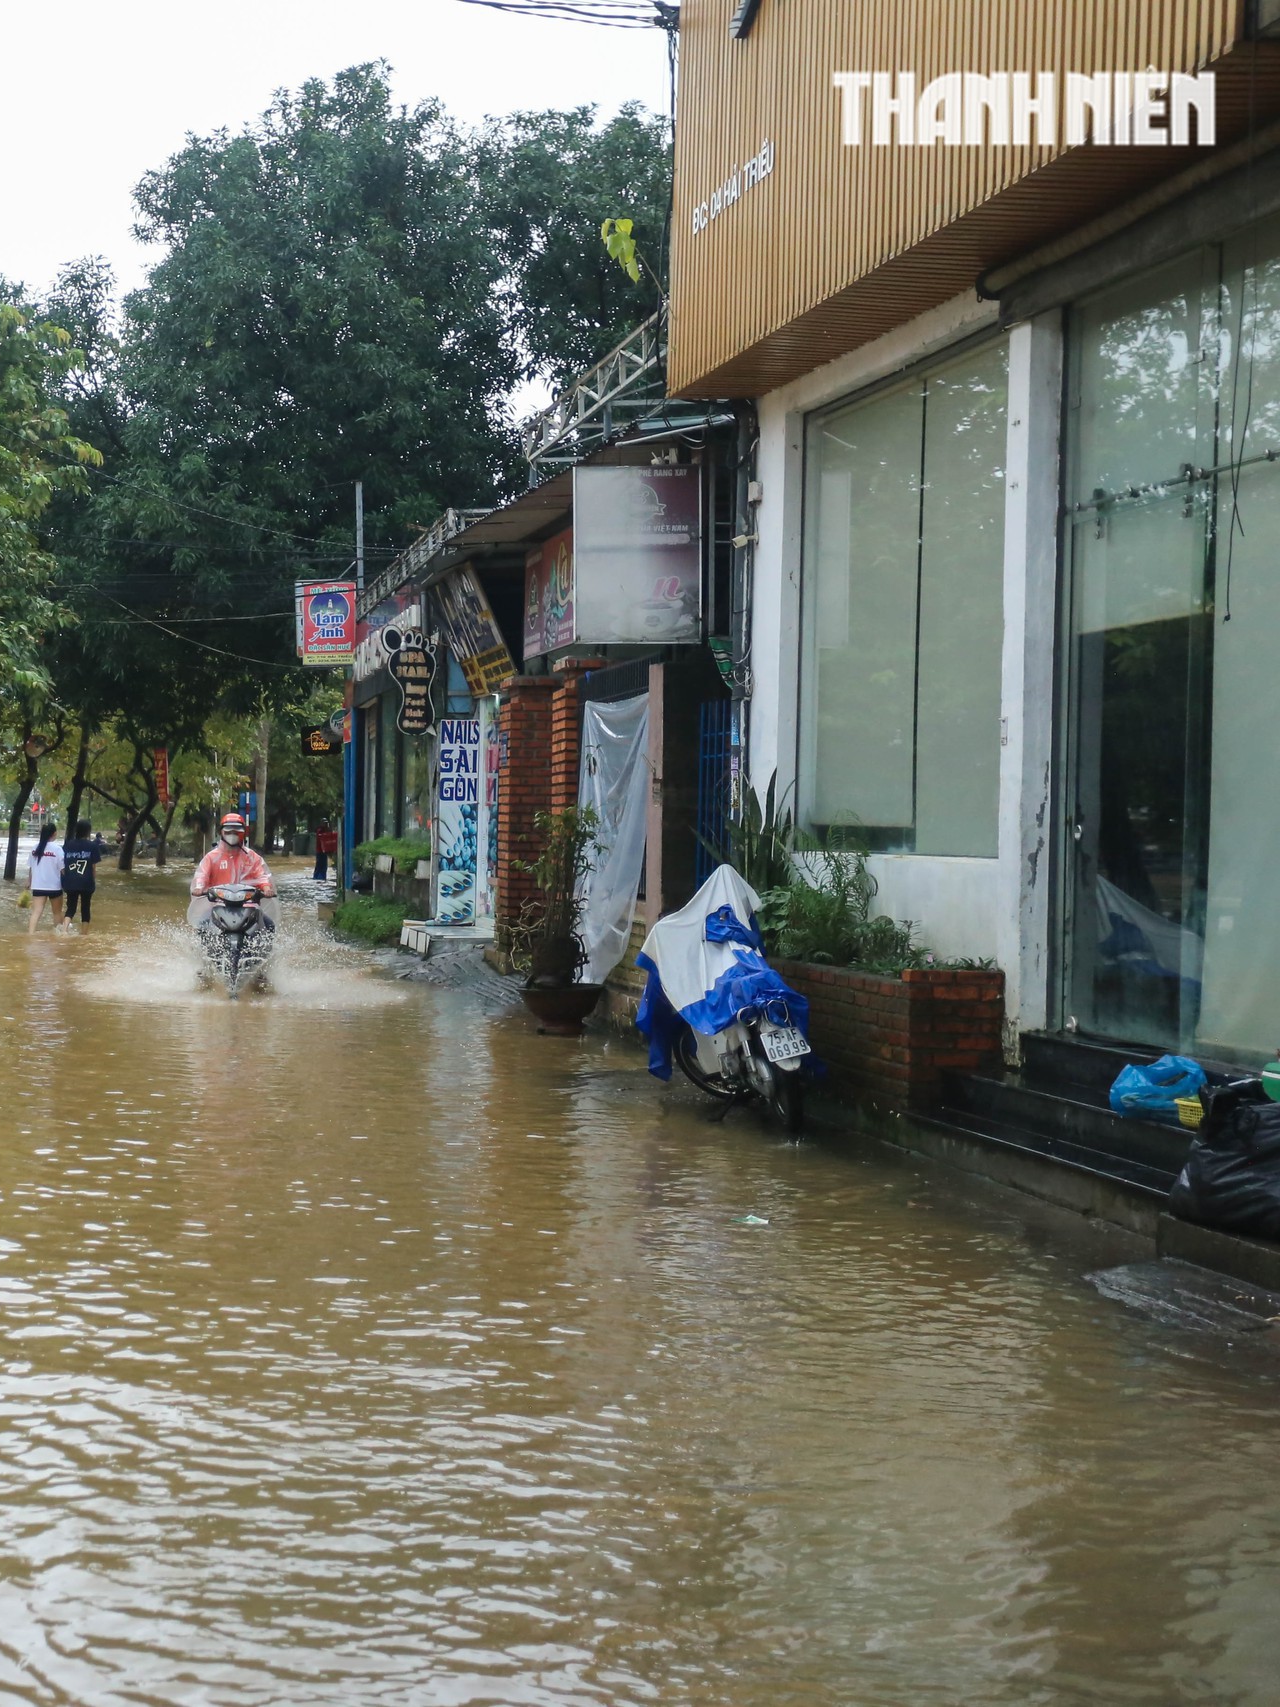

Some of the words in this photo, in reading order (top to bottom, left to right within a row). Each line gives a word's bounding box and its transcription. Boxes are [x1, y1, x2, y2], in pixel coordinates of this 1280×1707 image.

[710, 187, 722, 220] 04
[723, 163, 741, 209] HẢI
[308, 626, 346, 642] Anh
[399, 651, 426, 663] SPA
[441, 720, 480, 745] NAILS
[440, 745, 478, 773] SÀI
[440, 773, 478, 801] GÒN
[768, 1039, 808, 1059] 069.99
